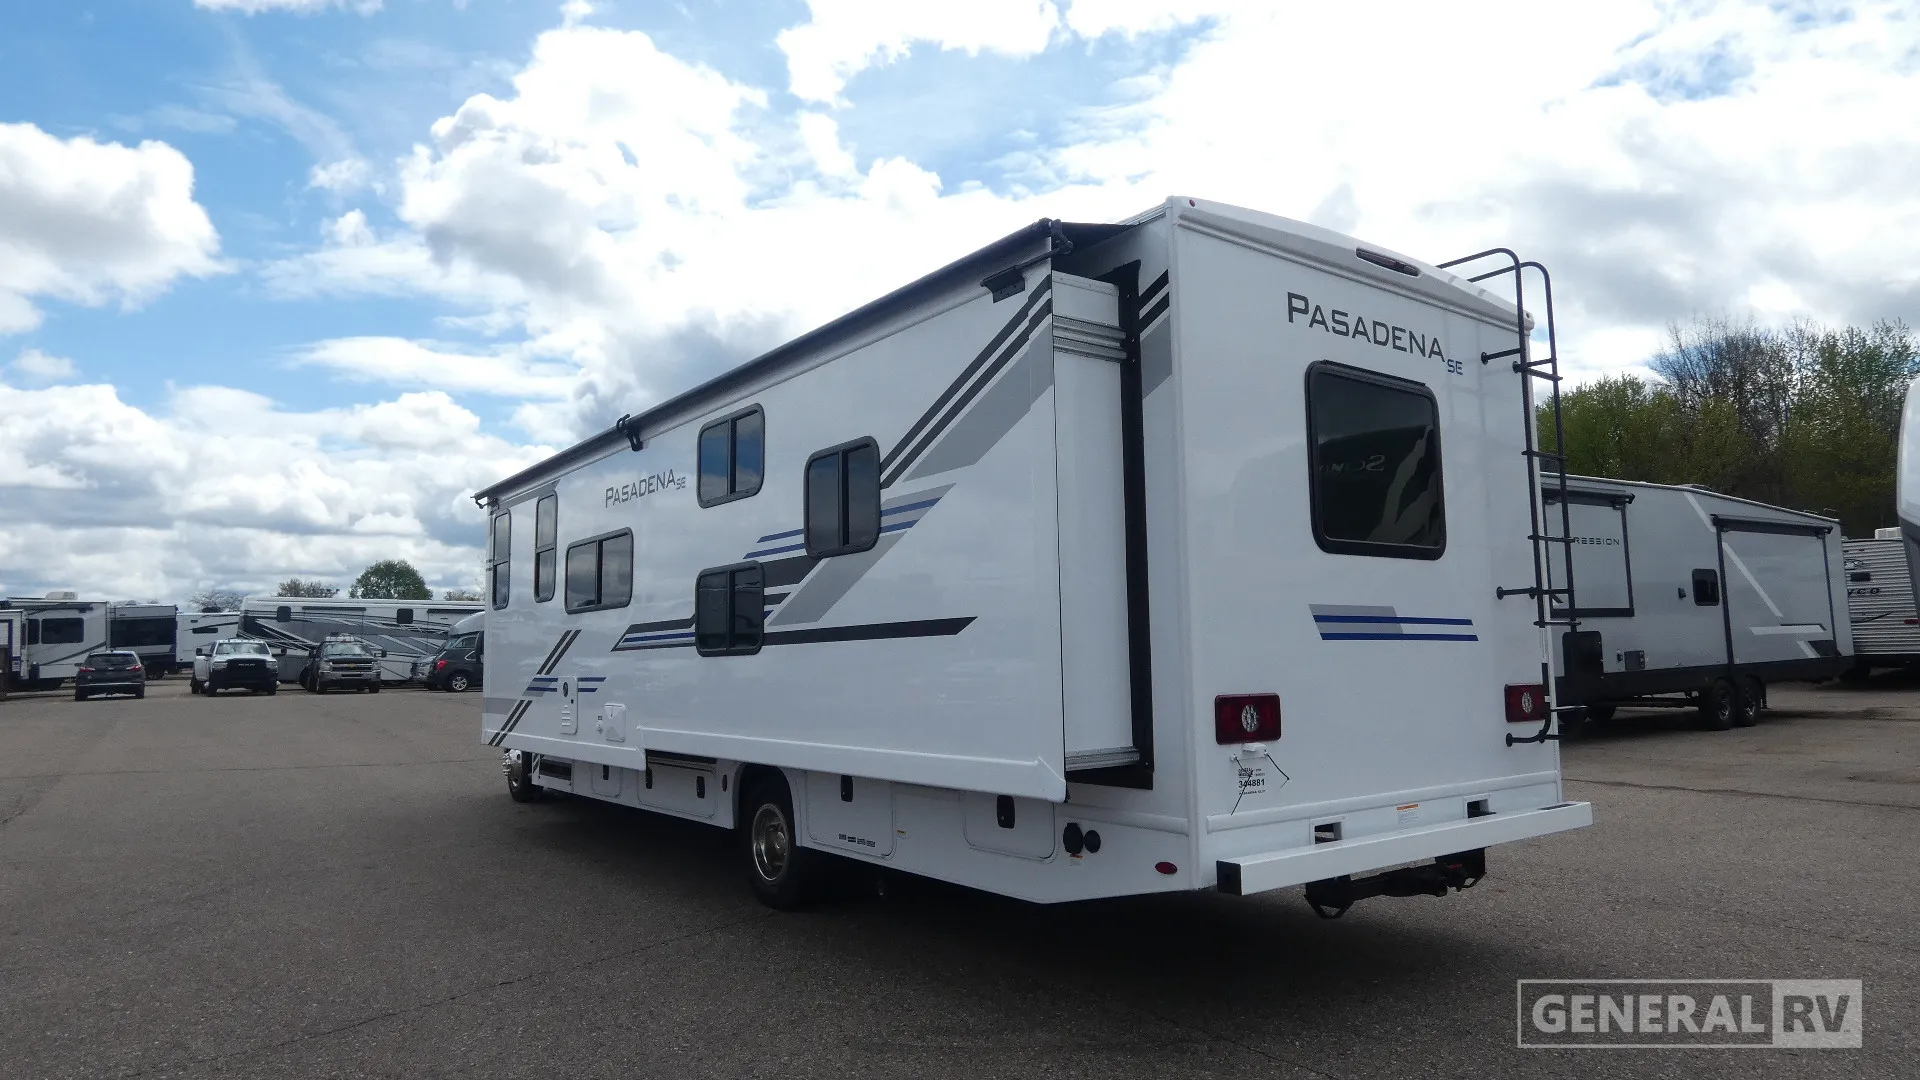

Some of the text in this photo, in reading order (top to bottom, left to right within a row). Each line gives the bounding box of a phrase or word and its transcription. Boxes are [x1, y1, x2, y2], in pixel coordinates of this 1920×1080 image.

[1287, 291, 1464, 376] PASADENA SE
[605, 468, 676, 509] PASADENA
[1238, 778, 1265, 789] 344881
